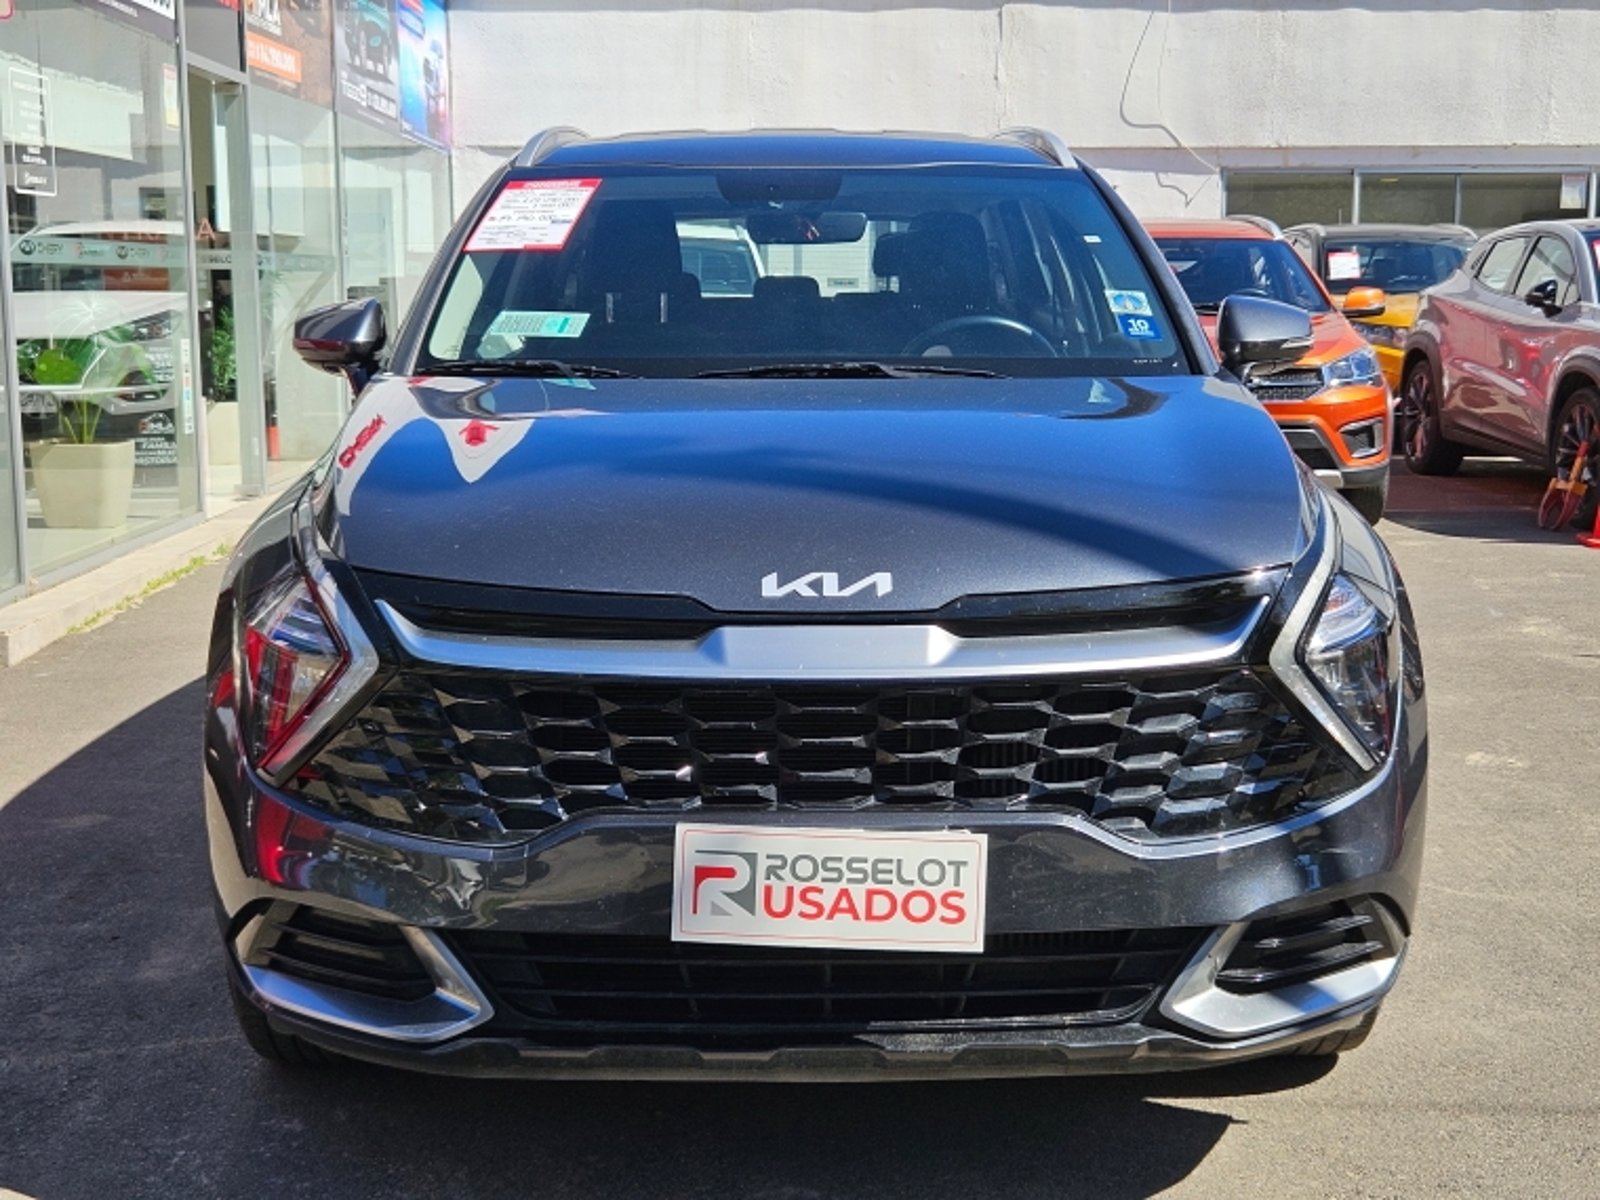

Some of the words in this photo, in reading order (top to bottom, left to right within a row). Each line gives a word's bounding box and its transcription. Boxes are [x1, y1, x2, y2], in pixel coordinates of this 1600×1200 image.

[761, 571, 893, 597] KIA
[764, 853, 969, 888] ROSSELOT
[763, 885, 967, 925] USADOS
